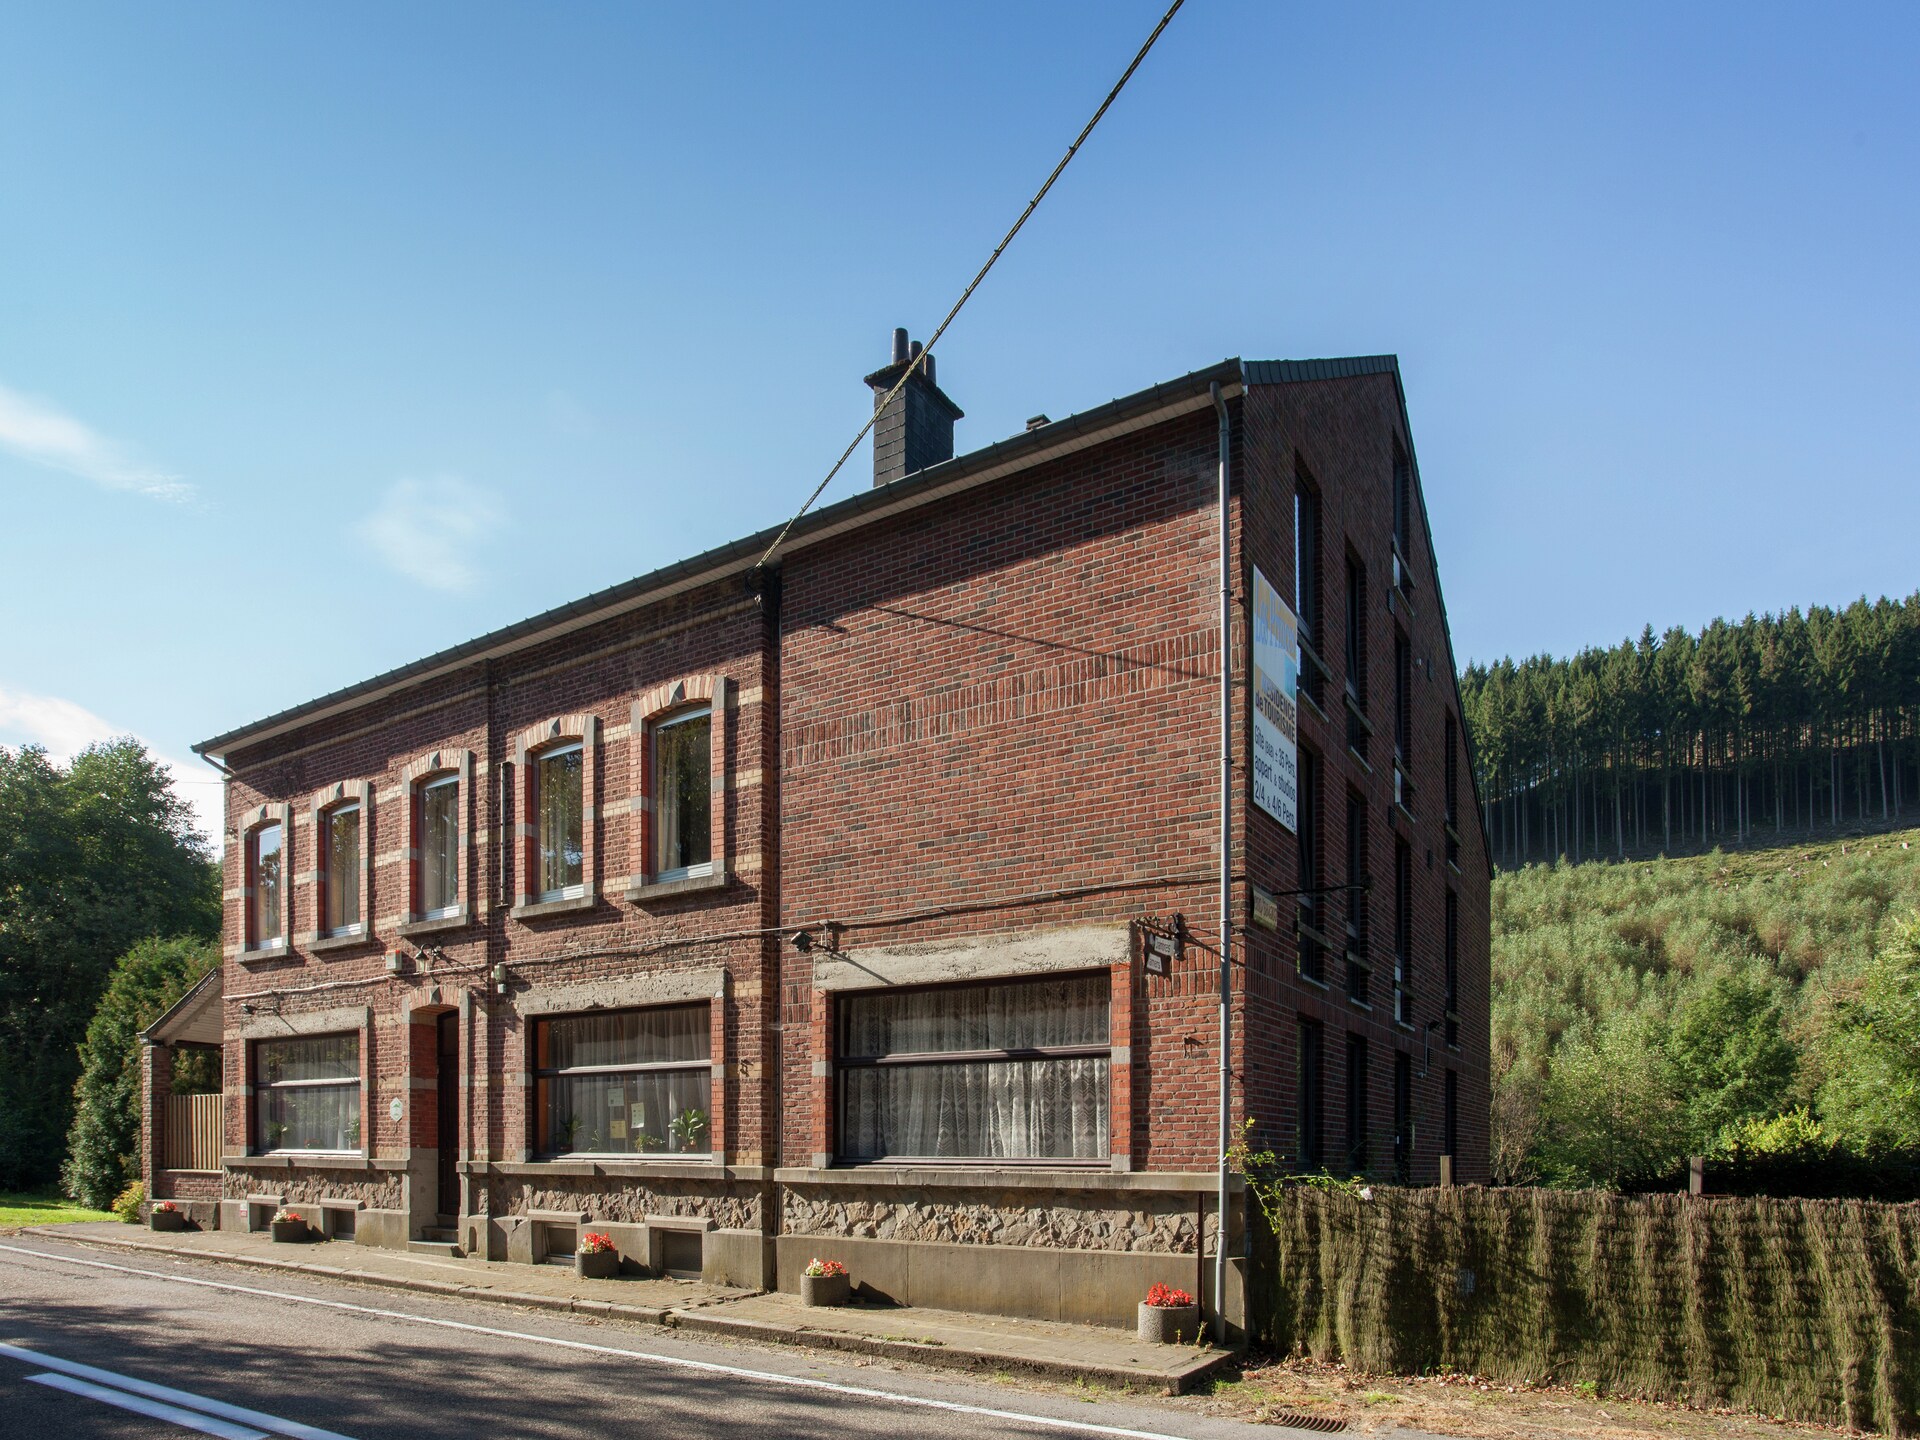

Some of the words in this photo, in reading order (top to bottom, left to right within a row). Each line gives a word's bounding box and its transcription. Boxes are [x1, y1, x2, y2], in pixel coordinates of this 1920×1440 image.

[1255, 689, 1264, 711] de
[1264, 696, 1295, 745] TOURISME
[1255, 755, 1273, 783] appart
[1278, 774, 1296, 803] studios
[1279, 747, 1285, 769] 35
[1285, 753, 1296, 779] Pers.
[1255, 780, 1265, 803] 2/4
[1266, 796, 1271, 809] &
[1272, 795, 1282, 819] 4/6
[1283, 803, 1296, 833] Pers.
